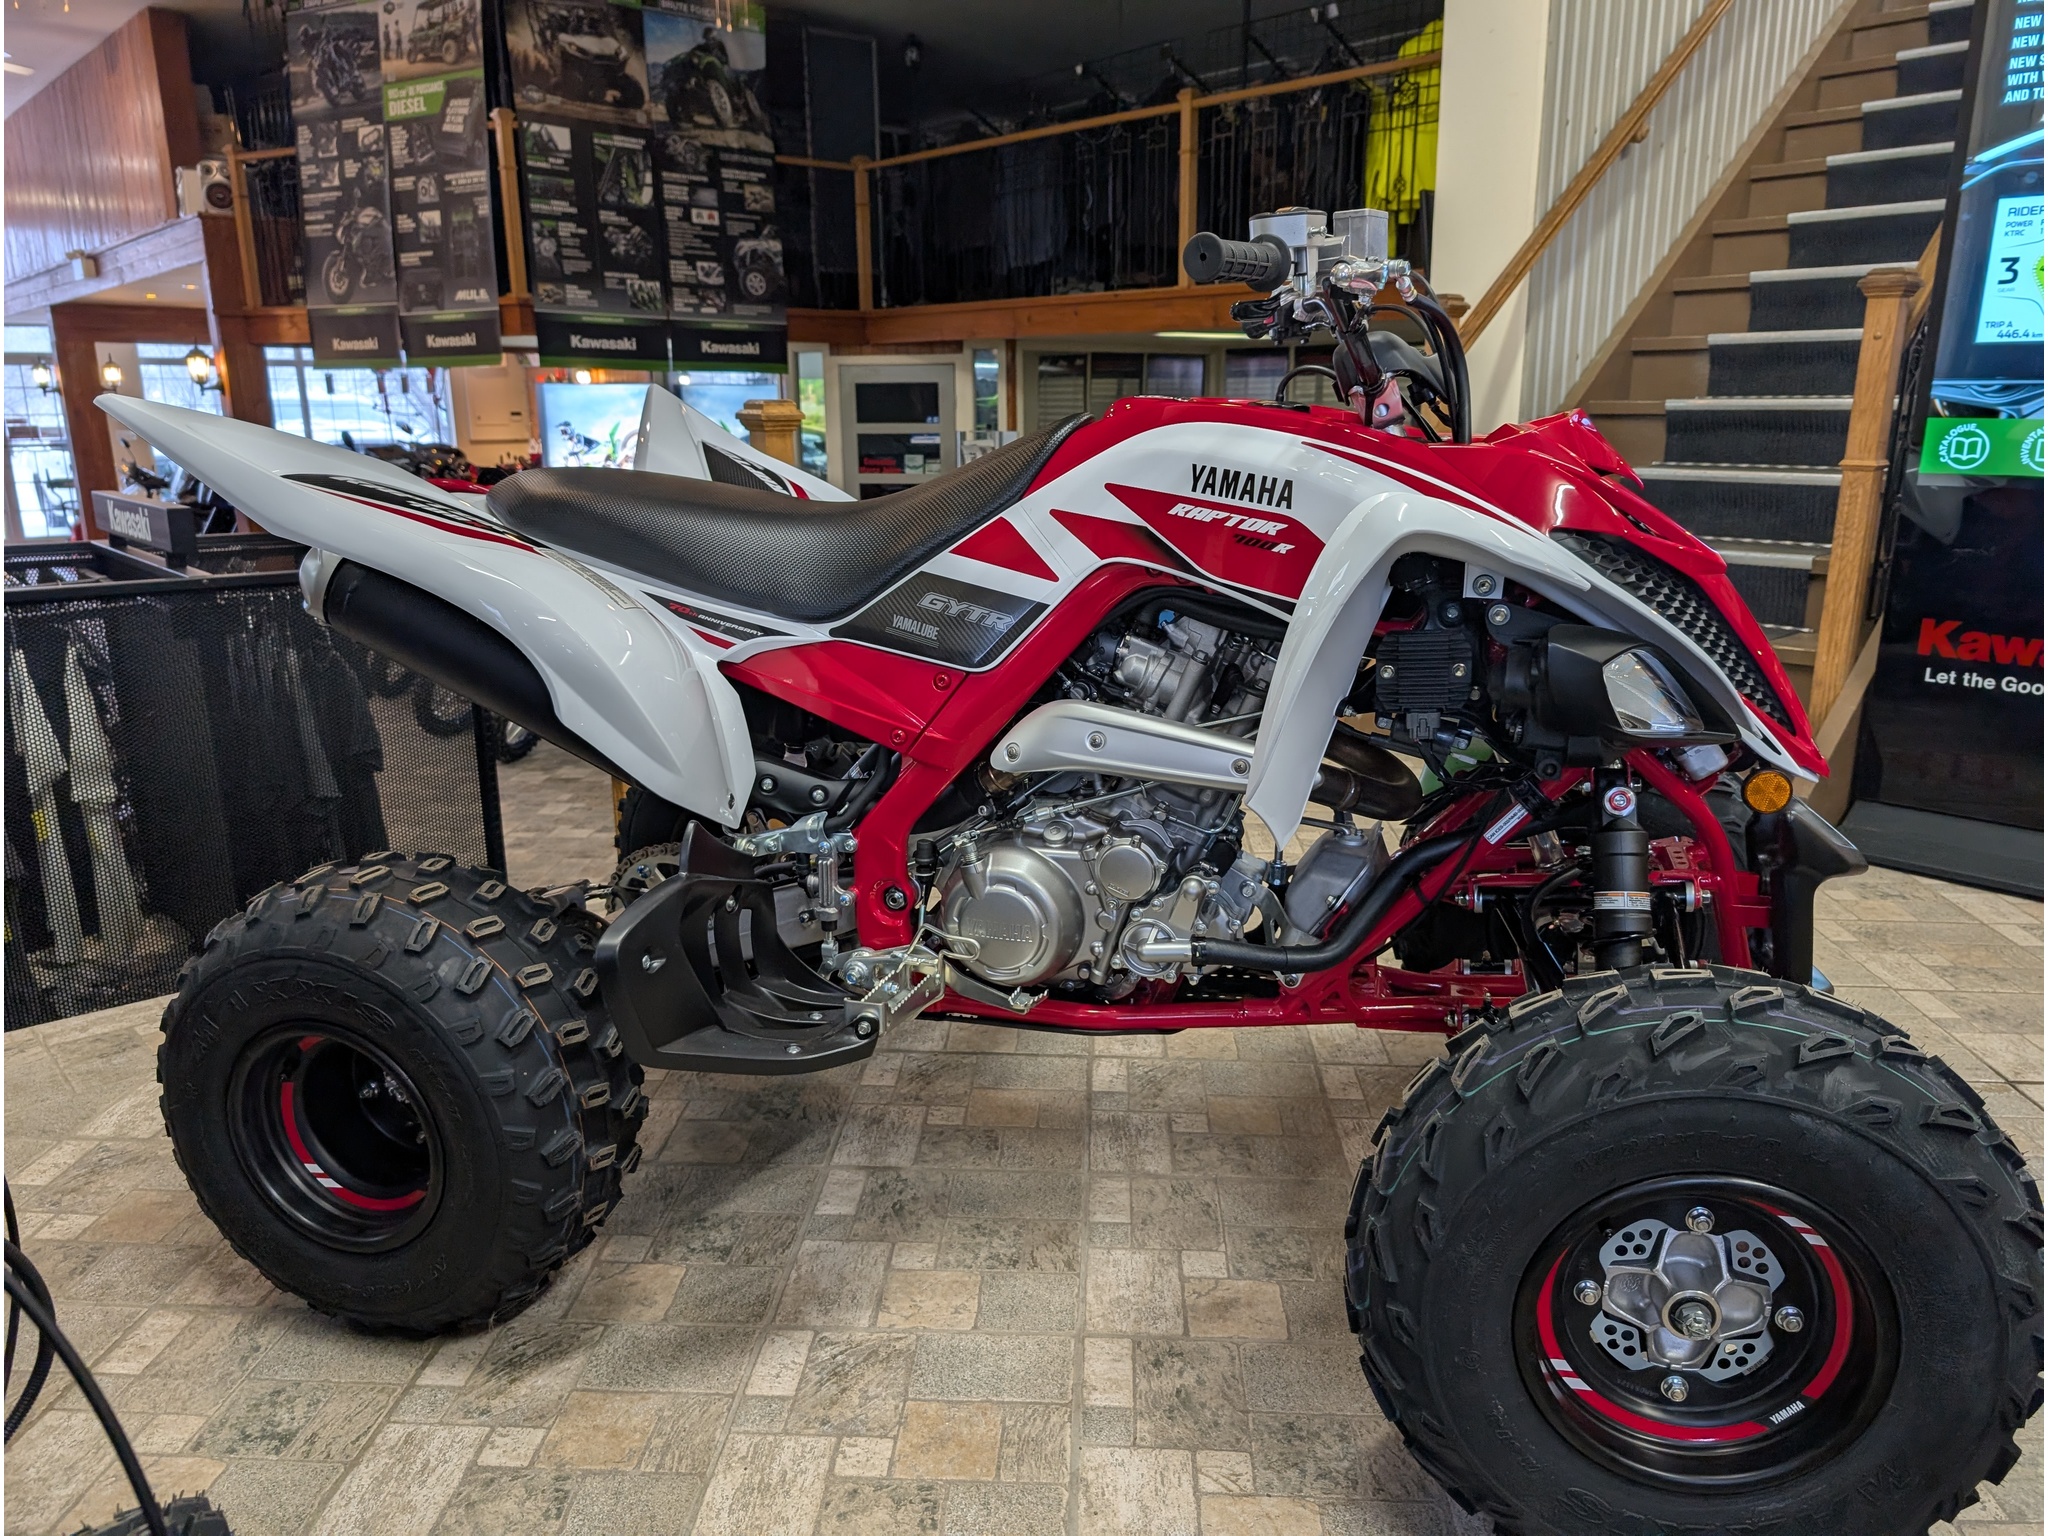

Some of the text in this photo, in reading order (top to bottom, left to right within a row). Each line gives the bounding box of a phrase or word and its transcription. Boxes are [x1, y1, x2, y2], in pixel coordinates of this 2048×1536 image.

[2014, 14, 2043, 30] NEW
[2011, 34, 2040, 50] NEW
[2009, 55, 2038, 70] NEW
[2007, 71, 2039, 86] WITH
[2003, 88, 2031, 104] AND
[388, 95, 427, 117] DIESEL
[2004, 229, 2026, 237] KTRC
[2005, 220, 2033, 229] POWER
[1997, 256, 2020, 285] 3
[455, 288, 490, 301] MULE
[1985, 321, 2005, 329] TRIP
[1997, 329, 2030, 339] 446.4
[332, 336, 379, 351] Kawasaki
[426, 332, 477, 348] Kawasaki
[570, 334, 637, 351] Kawasaki
[701, 340, 760, 355] Kawasaki
[1938, 423, 1977, 463] CATALOGUE
[1191, 463, 1293, 510] YAMAHA
[106, 499, 152, 542] Kawasaki
[1168, 503, 1289, 536] RAPTOR
[1233, 533, 1296, 554] 700R
[669, 602, 764, 637] 70th ANNIVERSARY
[917, 591, 1015, 632] GYTR
[892, 613, 940, 641] YAMALUBE
[1917, 617, 2044, 668] Kaw
[1924, 667, 2044, 695] Let the Goo
[966, 917, 1034, 943] YAMAHA
[1769, 1400, 1806, 1424] YAMAHA
